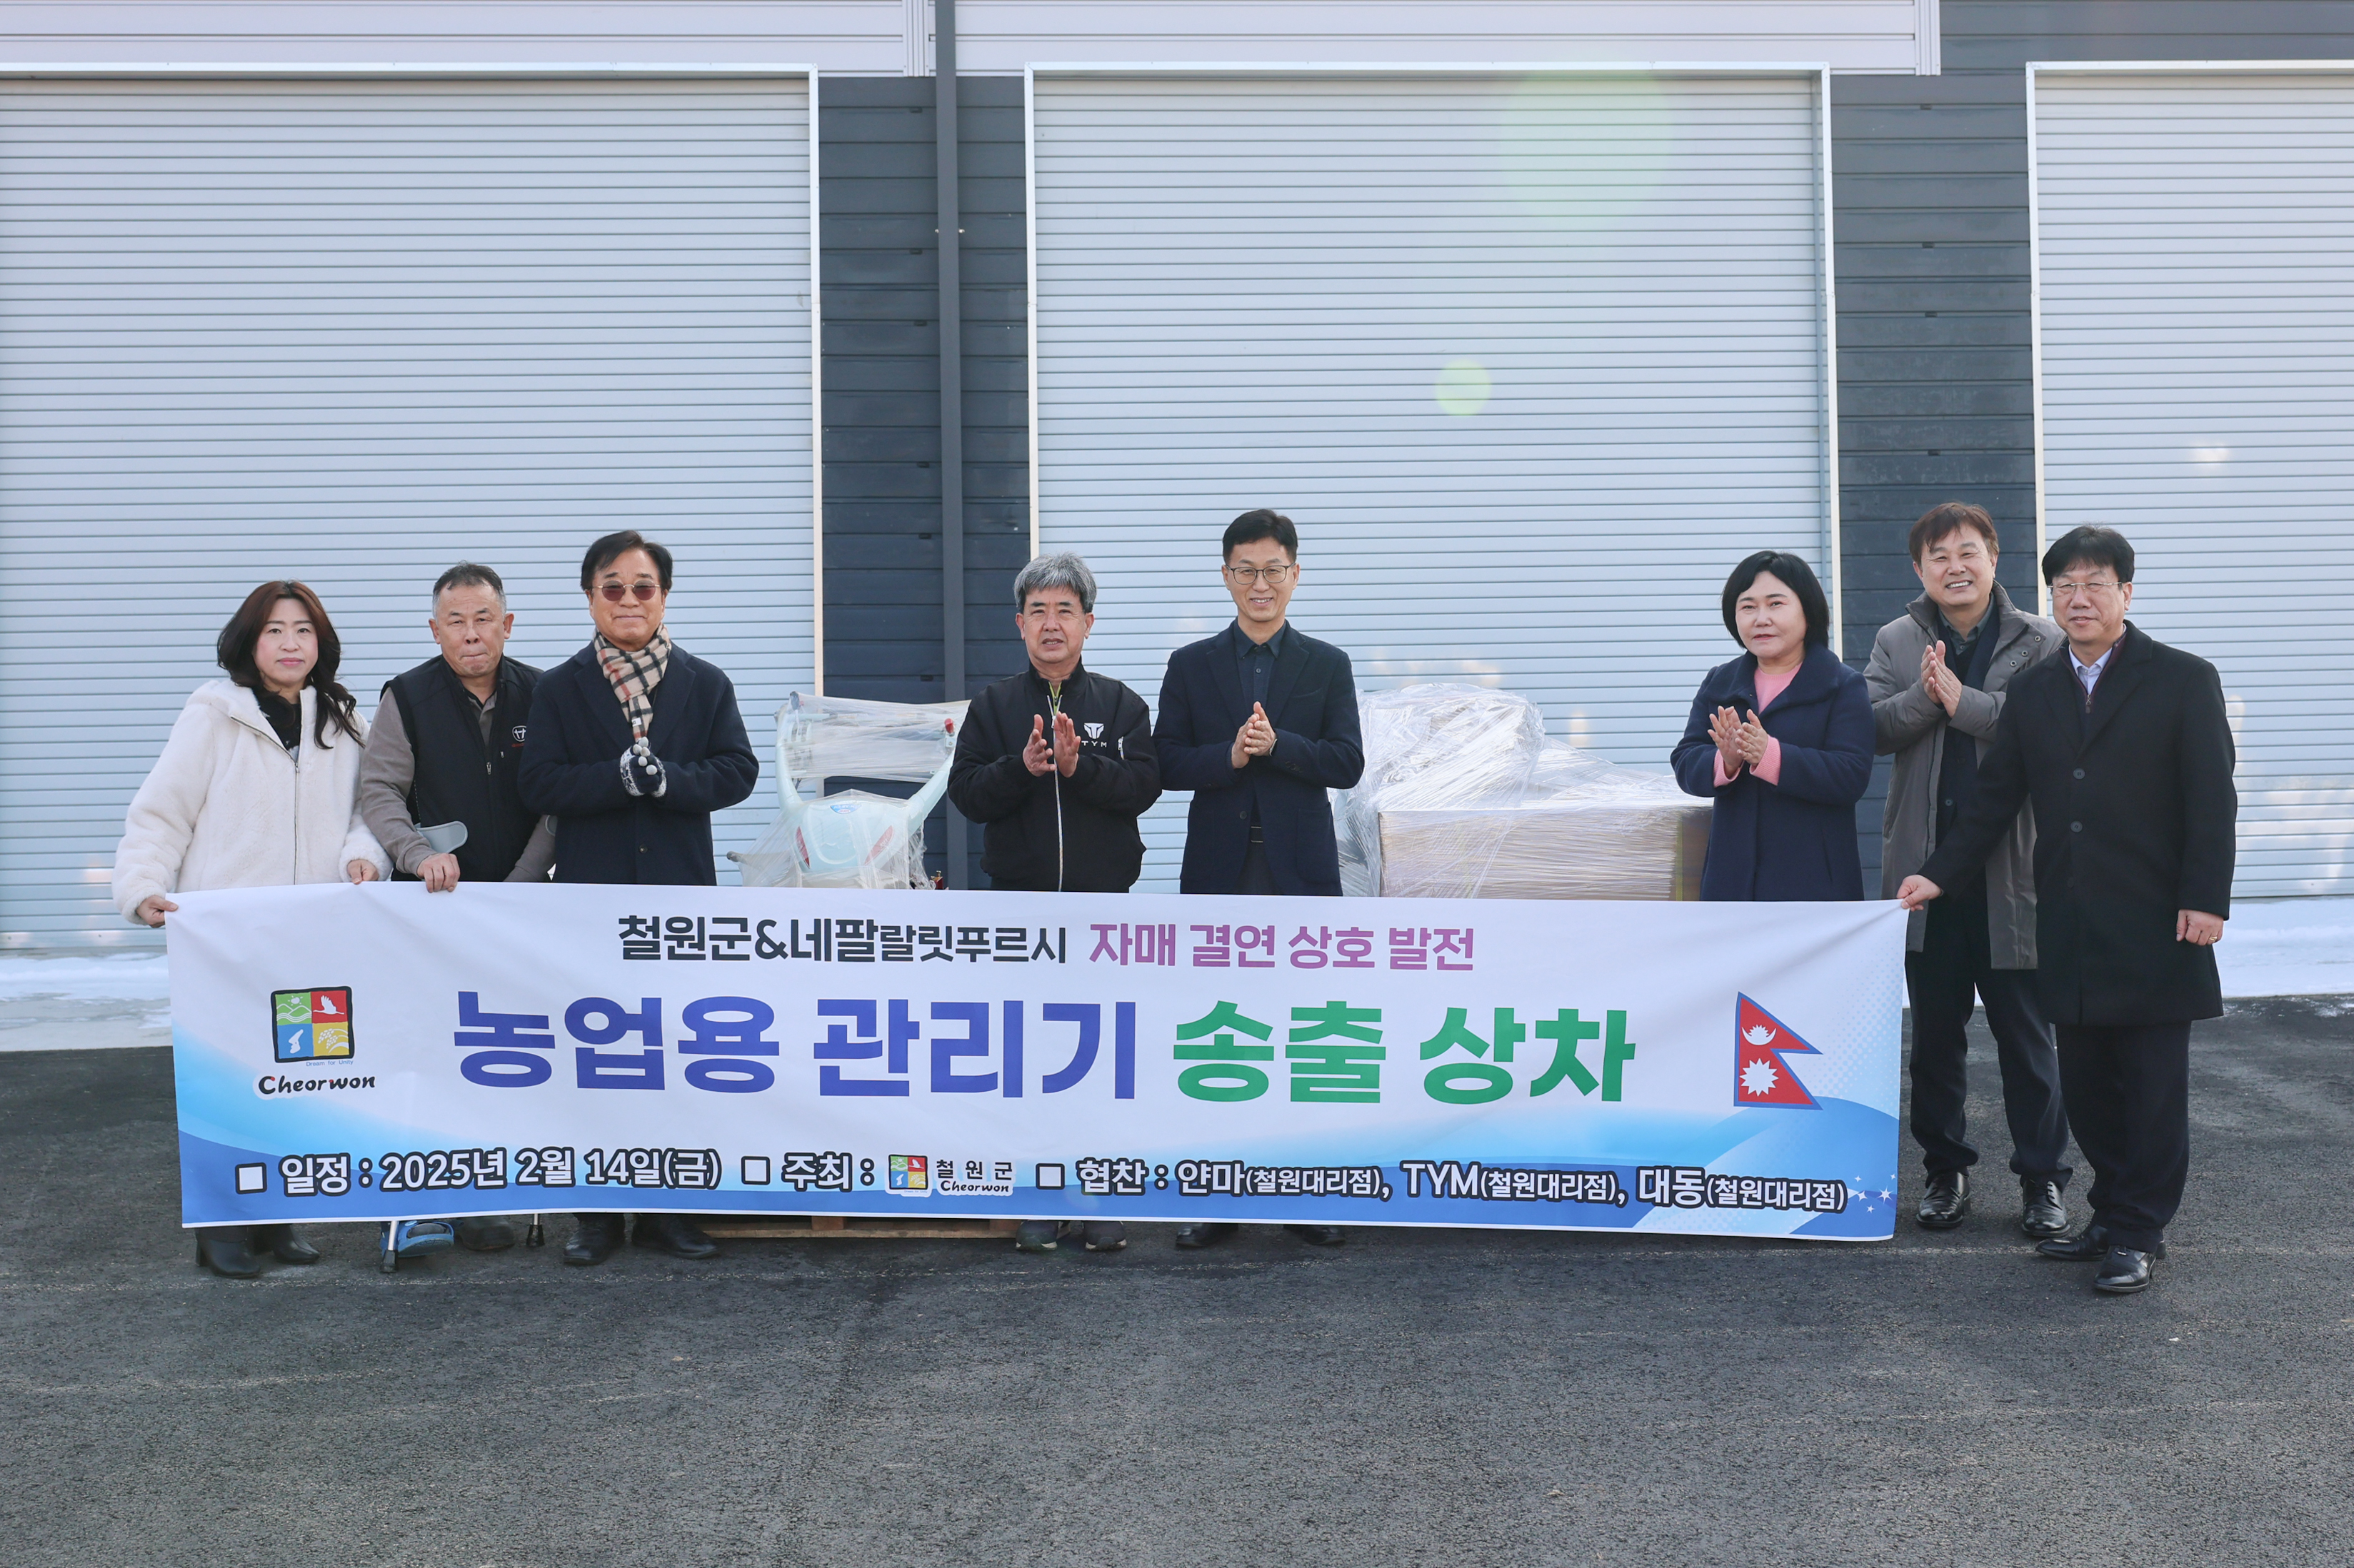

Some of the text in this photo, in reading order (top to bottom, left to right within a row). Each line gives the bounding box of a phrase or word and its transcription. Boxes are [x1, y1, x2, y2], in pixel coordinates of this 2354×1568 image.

[618, 915, 1473, 971] 철원군&네팔랄릿푸르시 자매 결연 상호 발전
[453, 990, 1636, 1105] 농업용 관리기 송출 상차
[258, 1075, 376, 1095] Cheorwon
[281, 1155, 349, 1194] 일정
[382, 1150, 506, 1188] 2025년
[517, 1150, 574, 1185] 2월
[587, 1150, 719, 1187] 14일(금)
[785, 1155, 851, 1191] 주최
[941, 1180, 1009, 1192] Cheorwon
[1077, 1160, 1146, 1193] 협찬
[1177, 1162, 1392, 1200] 얀마(철원대리점),
[1403, 1162, 1626, 1205] TYM(철원대리점),
[1640, 1168, 1846, 1210] 대동(철원대리점)
